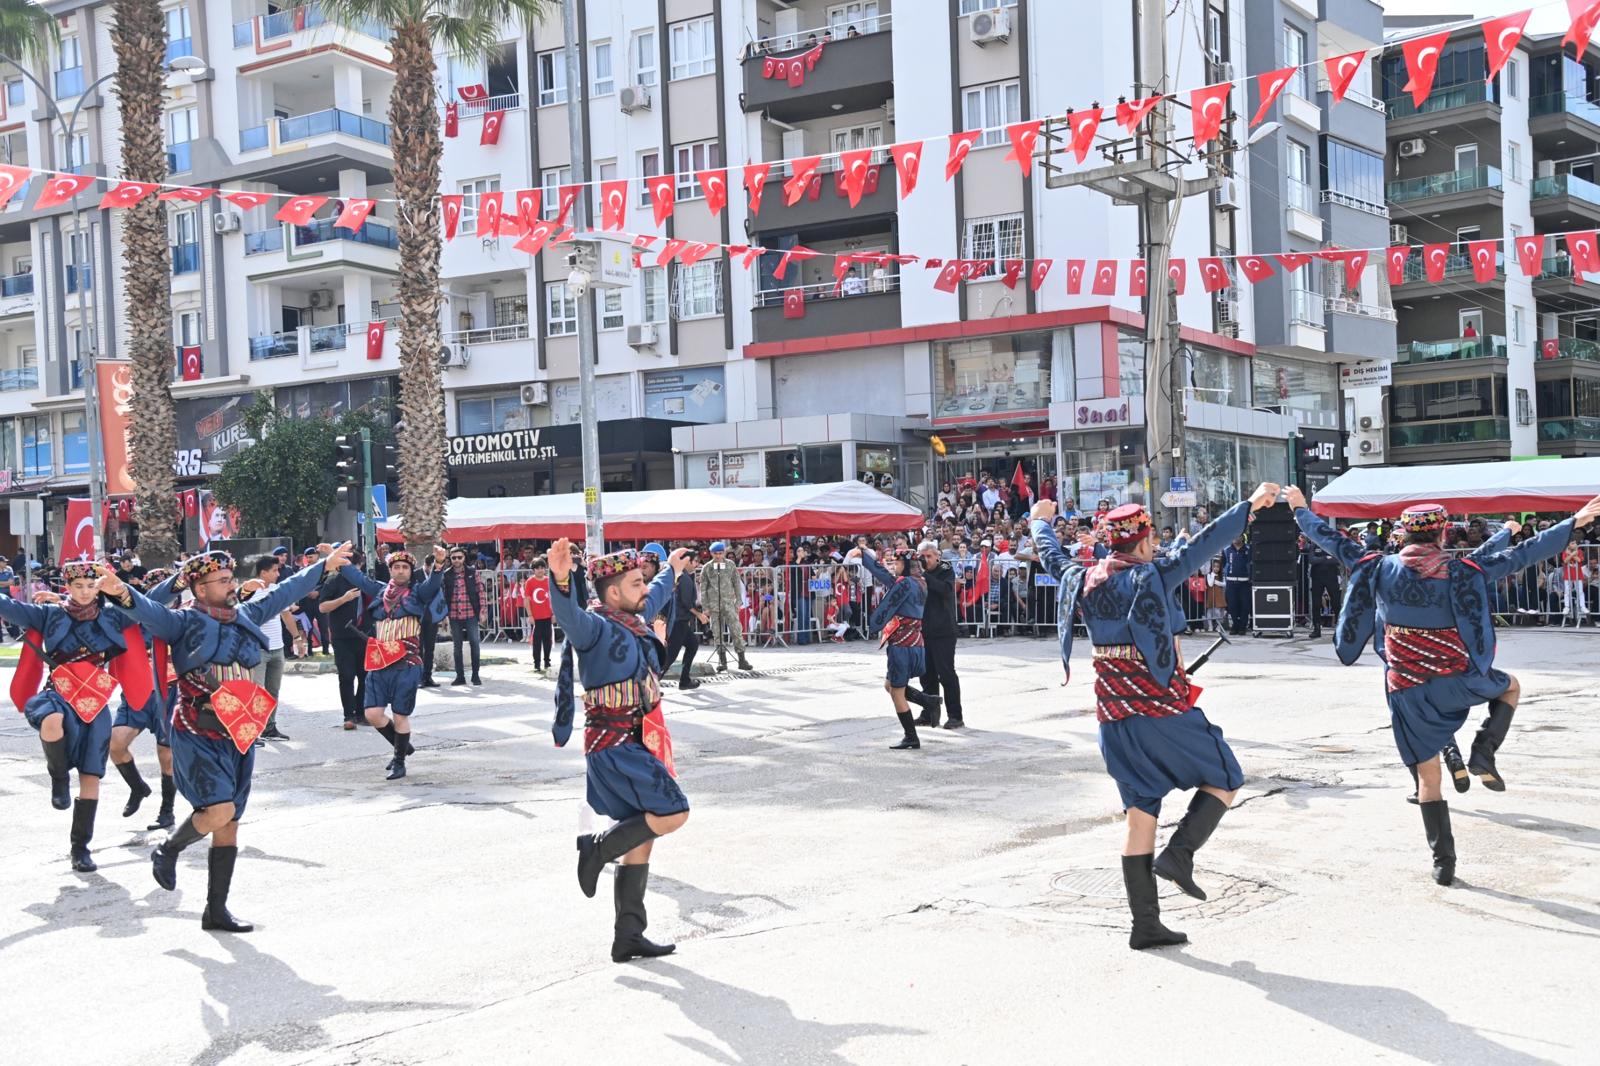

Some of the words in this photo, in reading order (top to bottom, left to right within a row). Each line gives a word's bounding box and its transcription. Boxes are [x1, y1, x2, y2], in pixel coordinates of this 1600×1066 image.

[1077, 403, 1127, 424] Suat
[173, 448, 202, 476] RS
[448, 449, 517, 466] GAYRİMENKUL
[709, 470, 739, 486] Sat
[1036, 575, 1056, 585] POL
